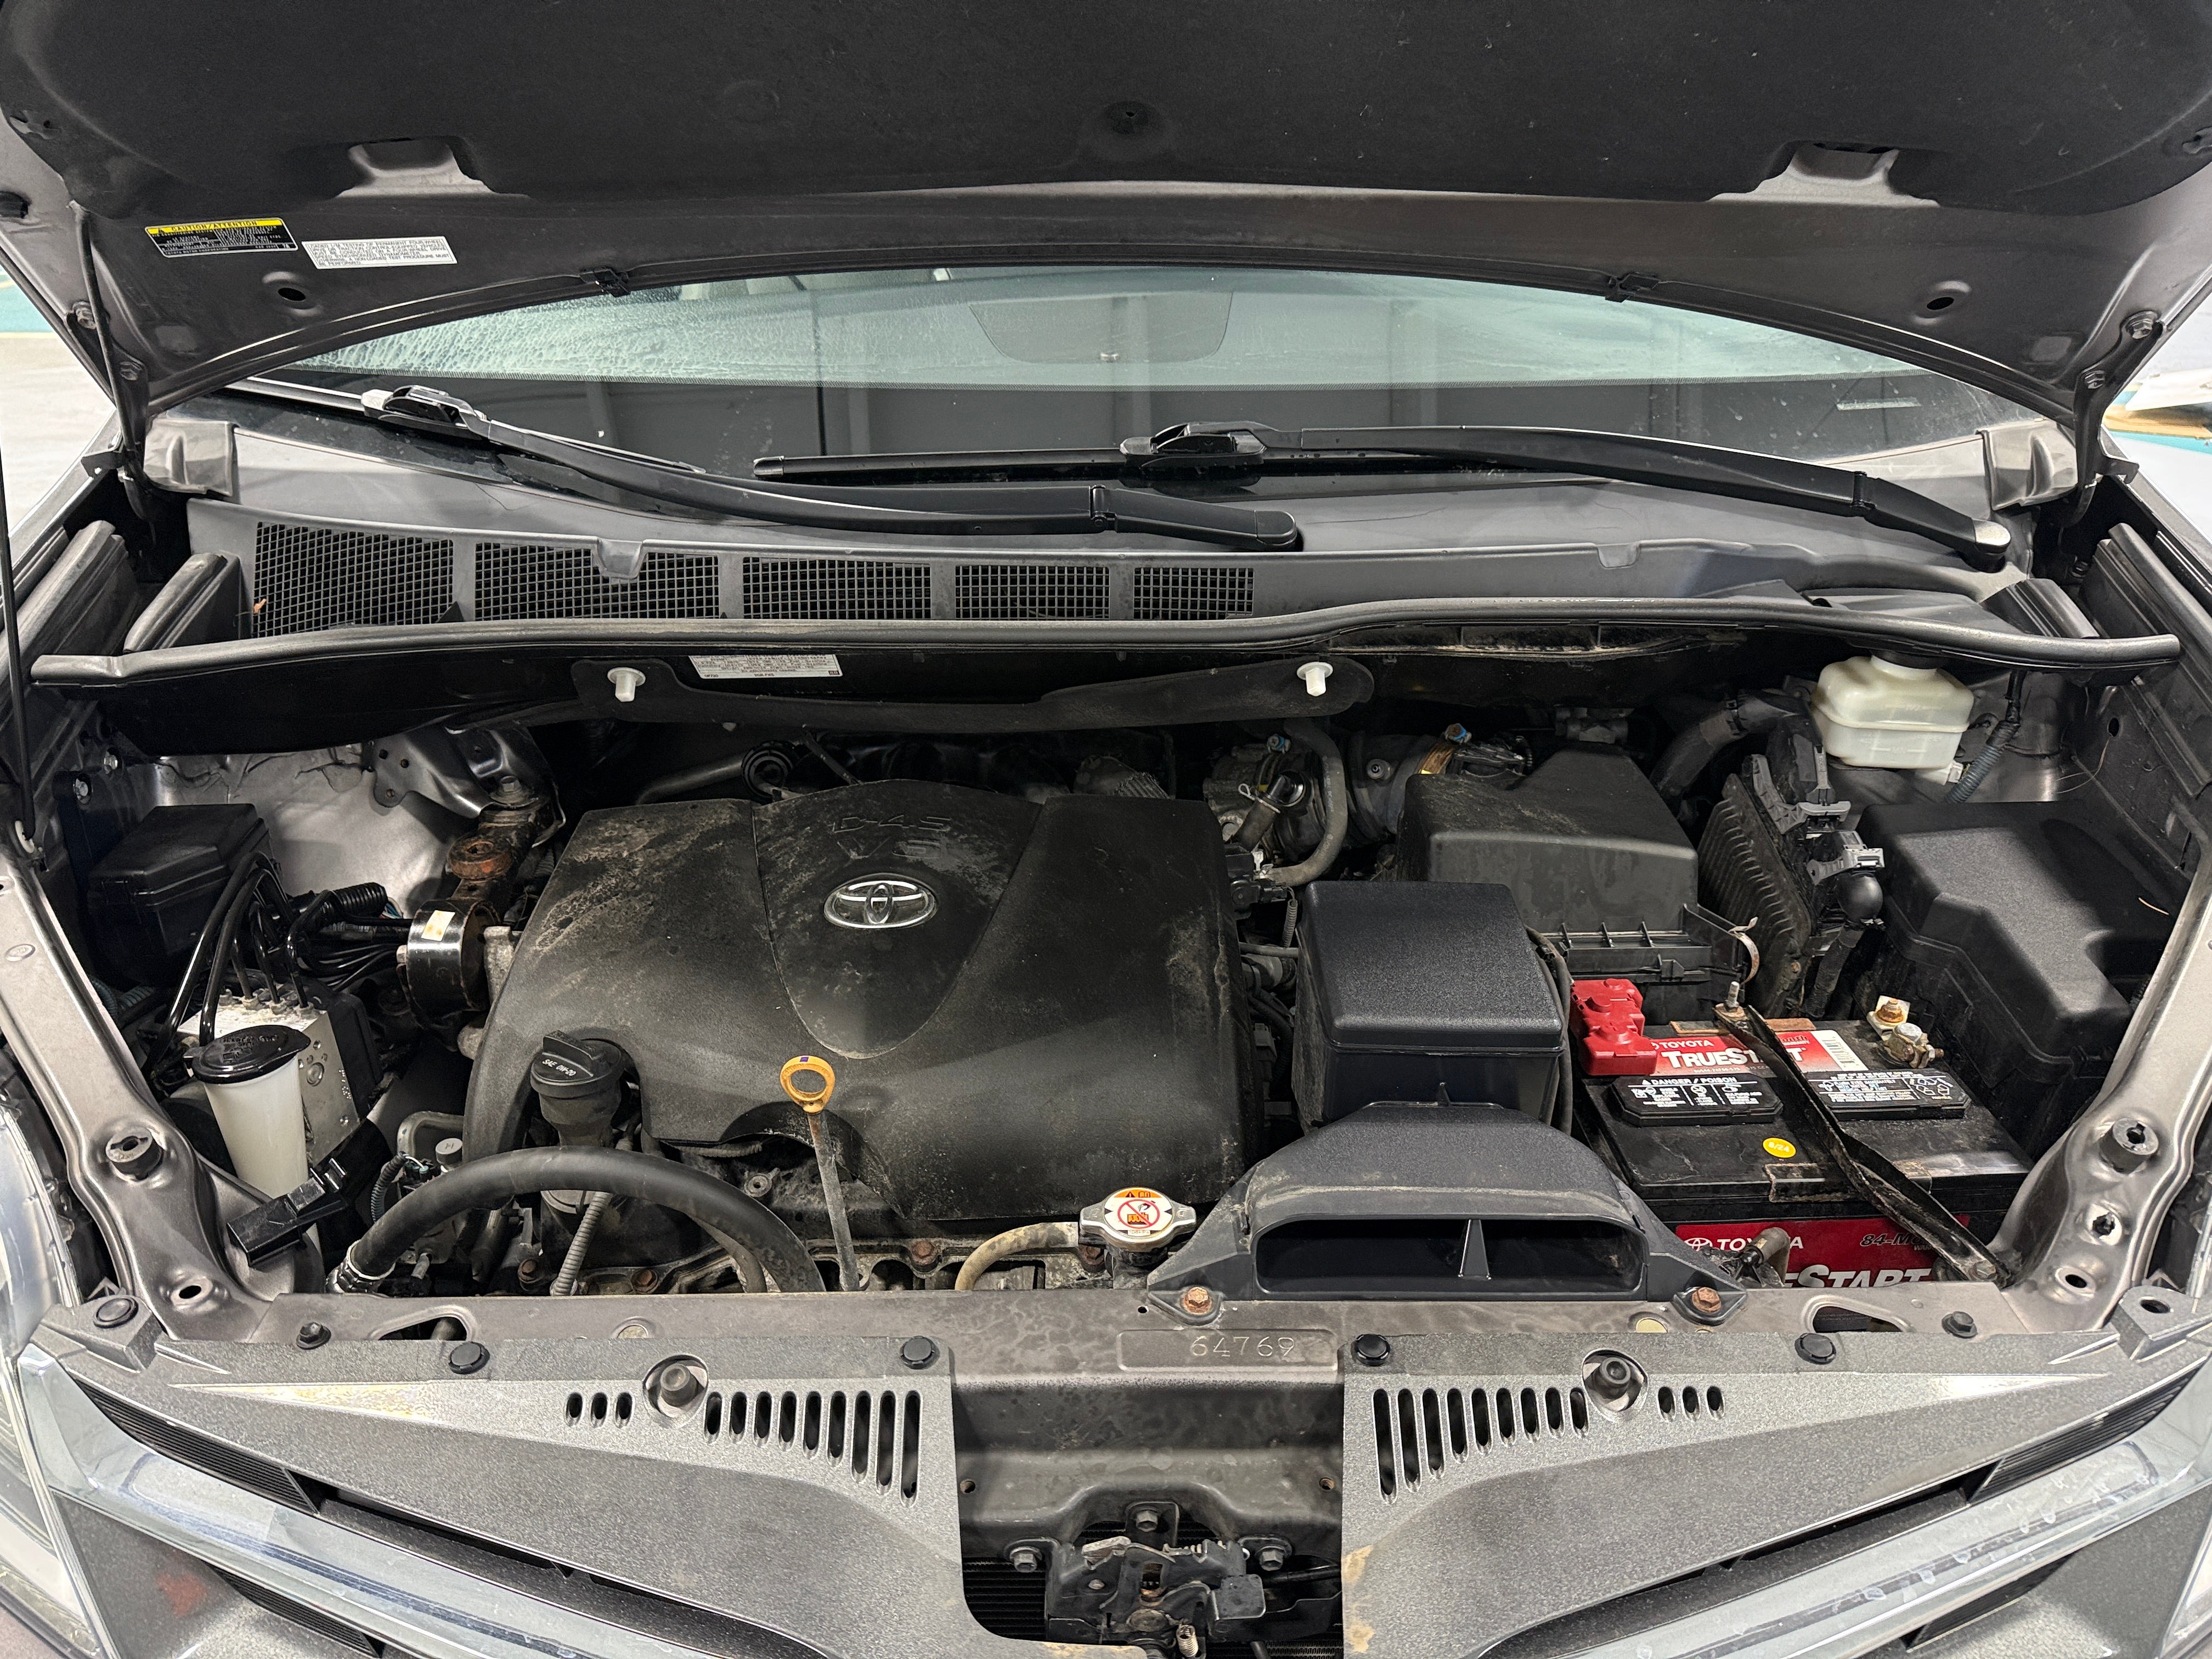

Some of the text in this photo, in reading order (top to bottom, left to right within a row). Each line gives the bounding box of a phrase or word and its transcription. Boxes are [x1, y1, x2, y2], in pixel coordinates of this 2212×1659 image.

[1659, 1040, 1714, 1049] TOYOTA
[542, 1059, 577, 1076] SAE 0W-20
[1191, 1335, 1295, 1357] 64769
